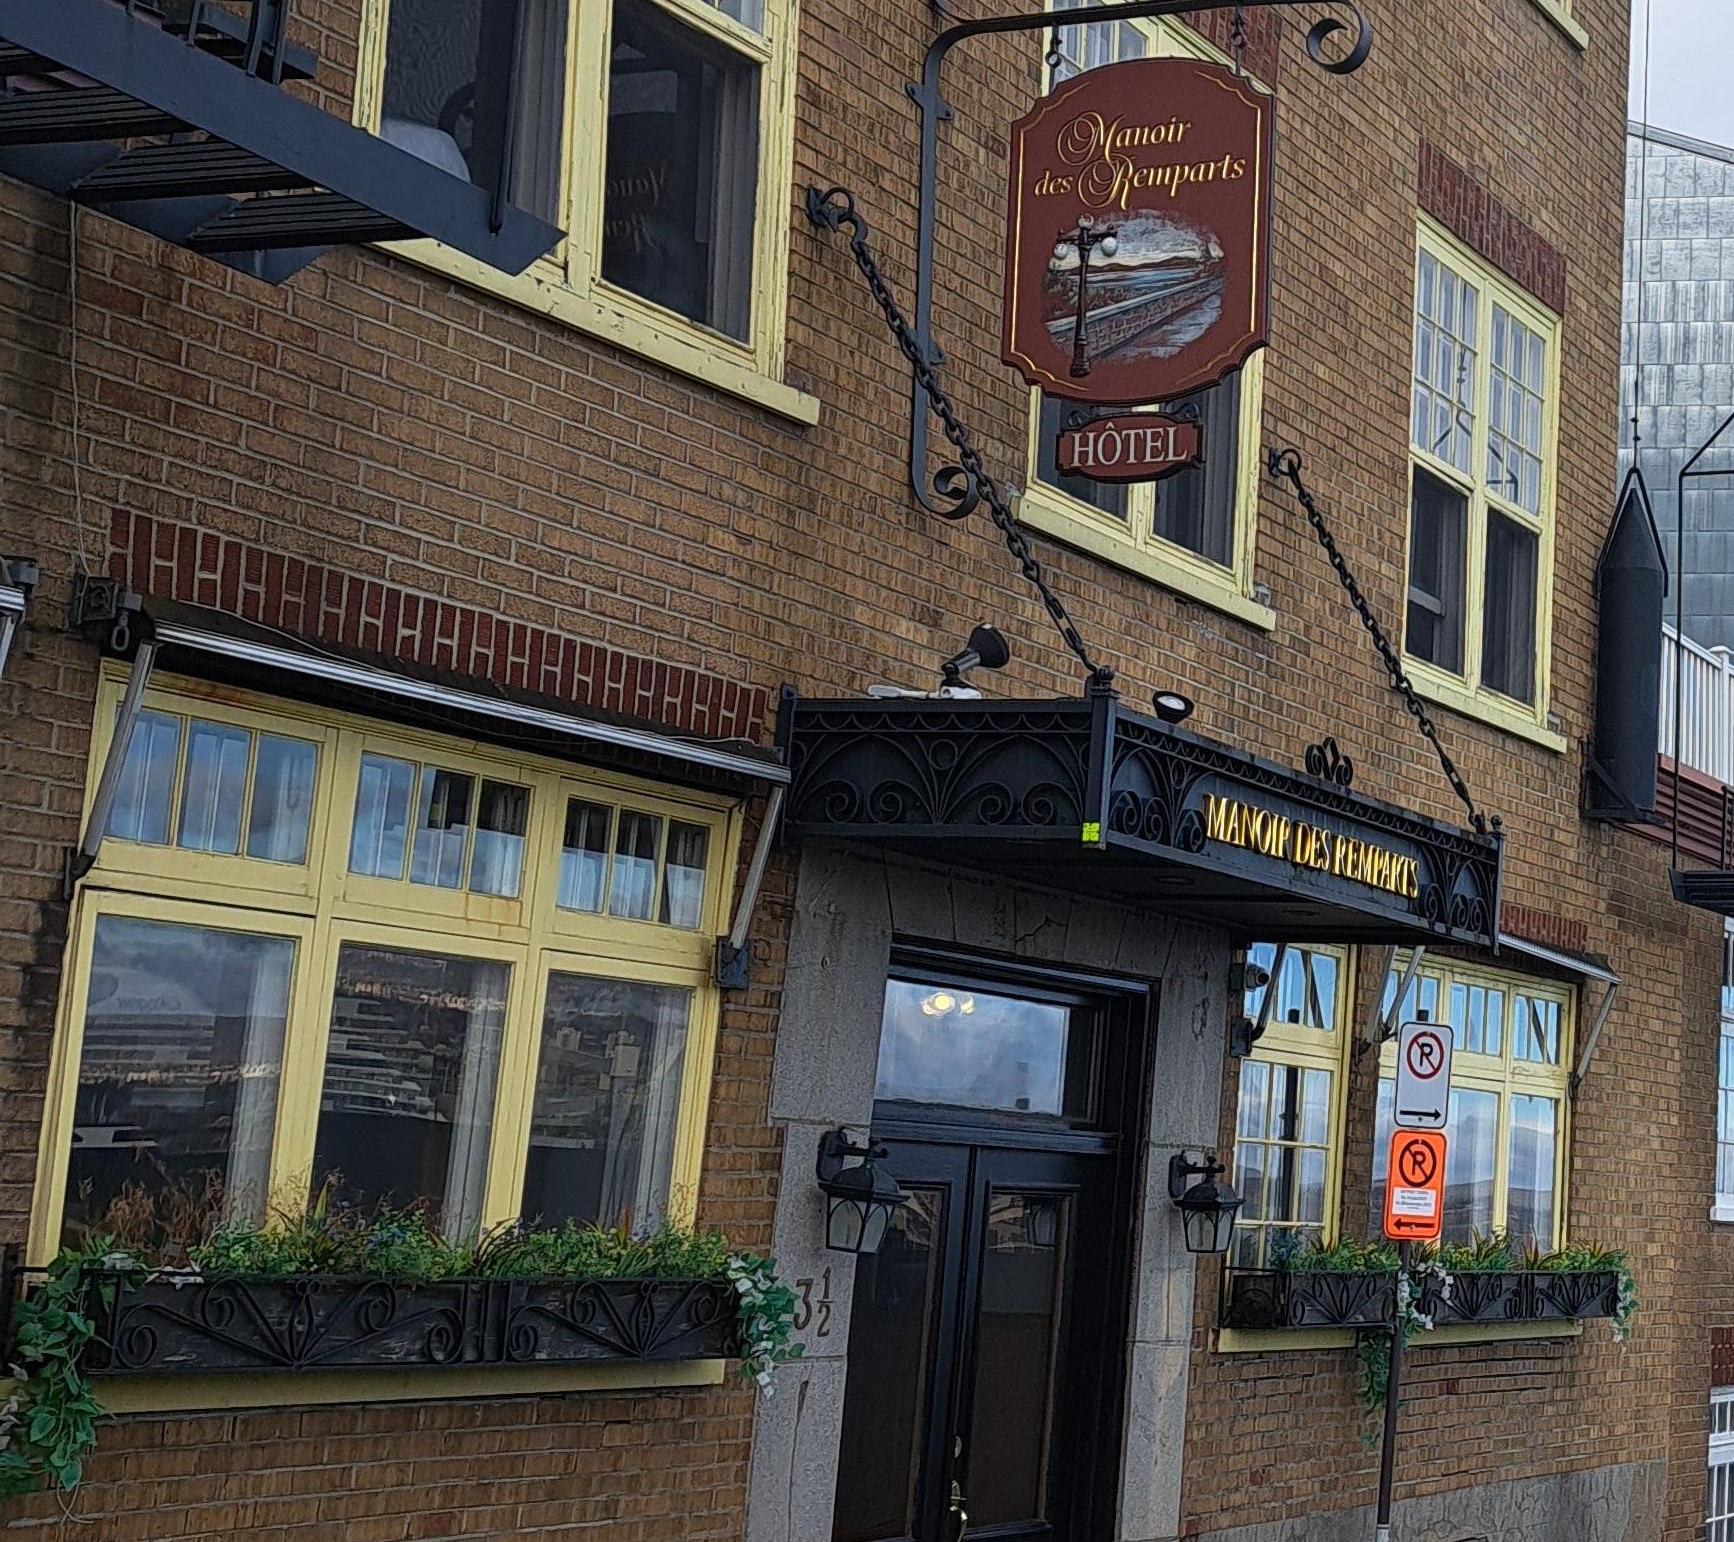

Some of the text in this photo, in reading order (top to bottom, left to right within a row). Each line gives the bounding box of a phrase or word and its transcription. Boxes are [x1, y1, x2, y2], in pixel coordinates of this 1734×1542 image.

[1057, 111, 1192, 166] Manoir
[1034, 152, 1246, 210] des Remparts
[1070, 421, 1188, 468] HÔTEL
[1205, 792, 1420, 899] MANOIR DES REMPARTS
